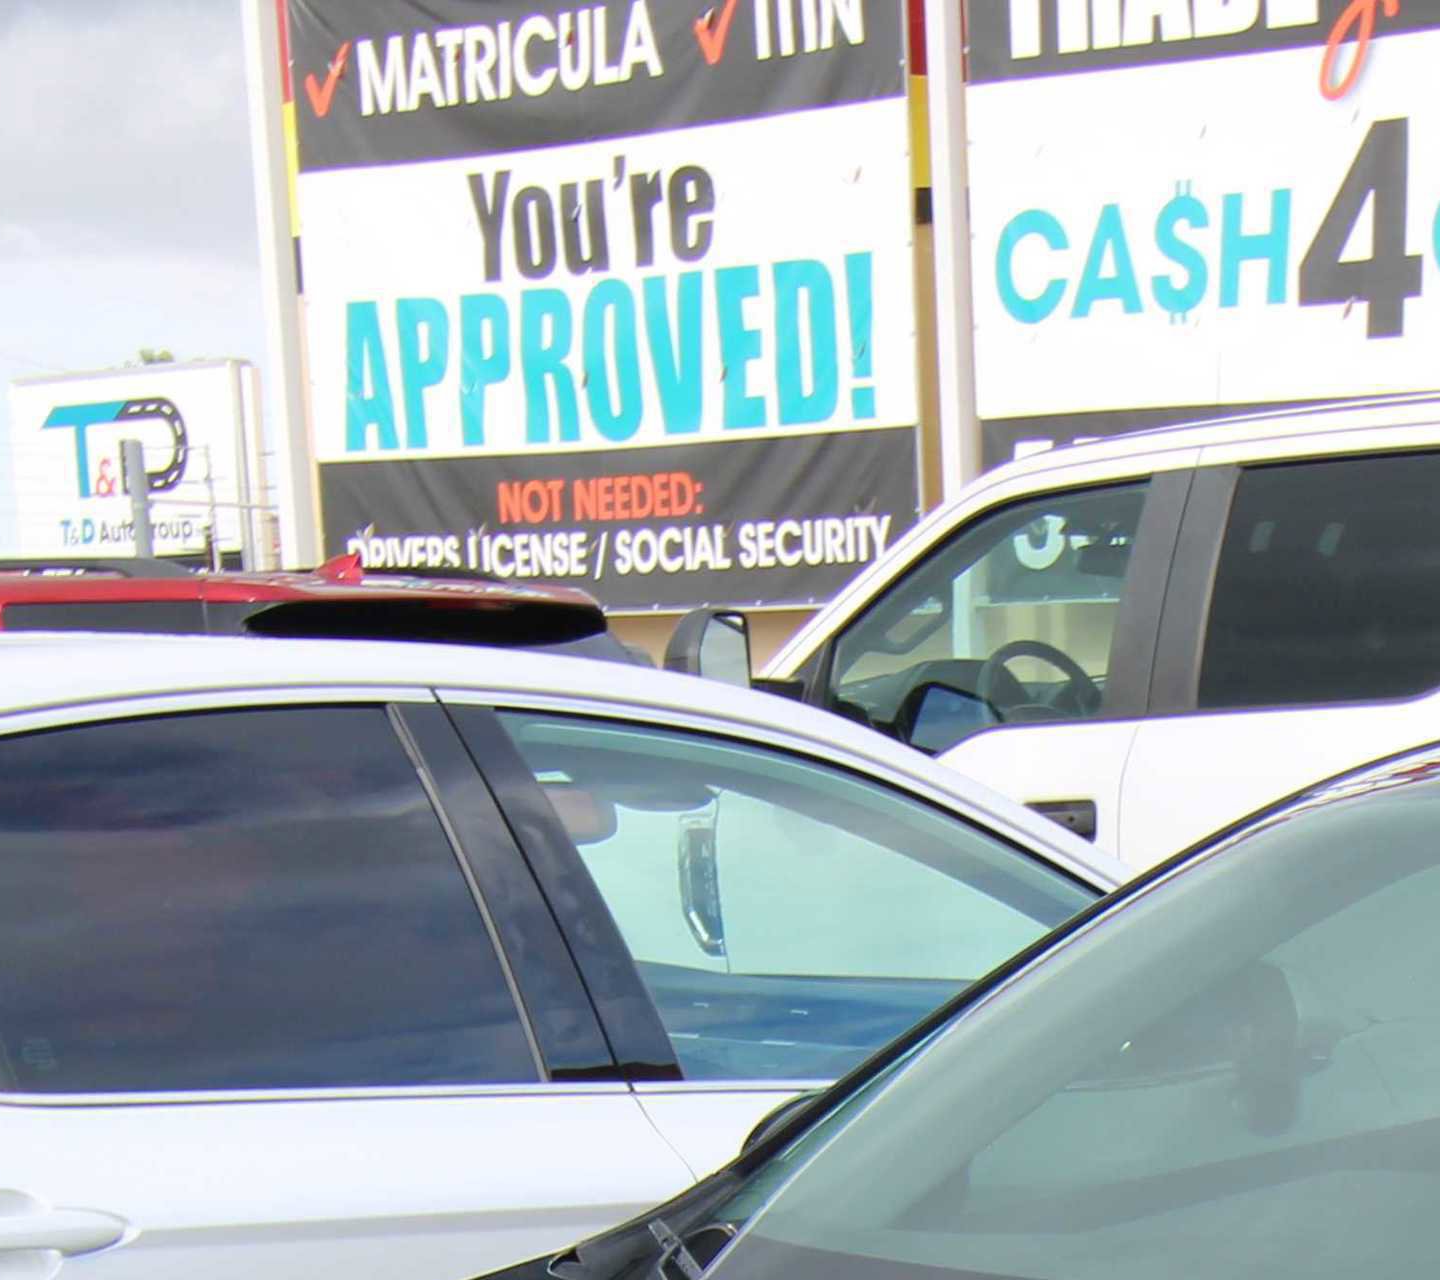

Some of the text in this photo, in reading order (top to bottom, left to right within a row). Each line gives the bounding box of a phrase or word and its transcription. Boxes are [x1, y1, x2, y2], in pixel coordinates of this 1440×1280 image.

[356, 0, 663, 117] MATRICULA
[466, 154, 716, 283] You're
[1298, 116, 1423, 340] 4
[345, 250, 877, 453] APPROVED!
[468, 531, 588, 579] LICENSE
[615, 525, 730, 574] SOCIAL
[738, 515, 893, 568] SECURITY
[497, 471, 705, 524] NOT NEEDED:
